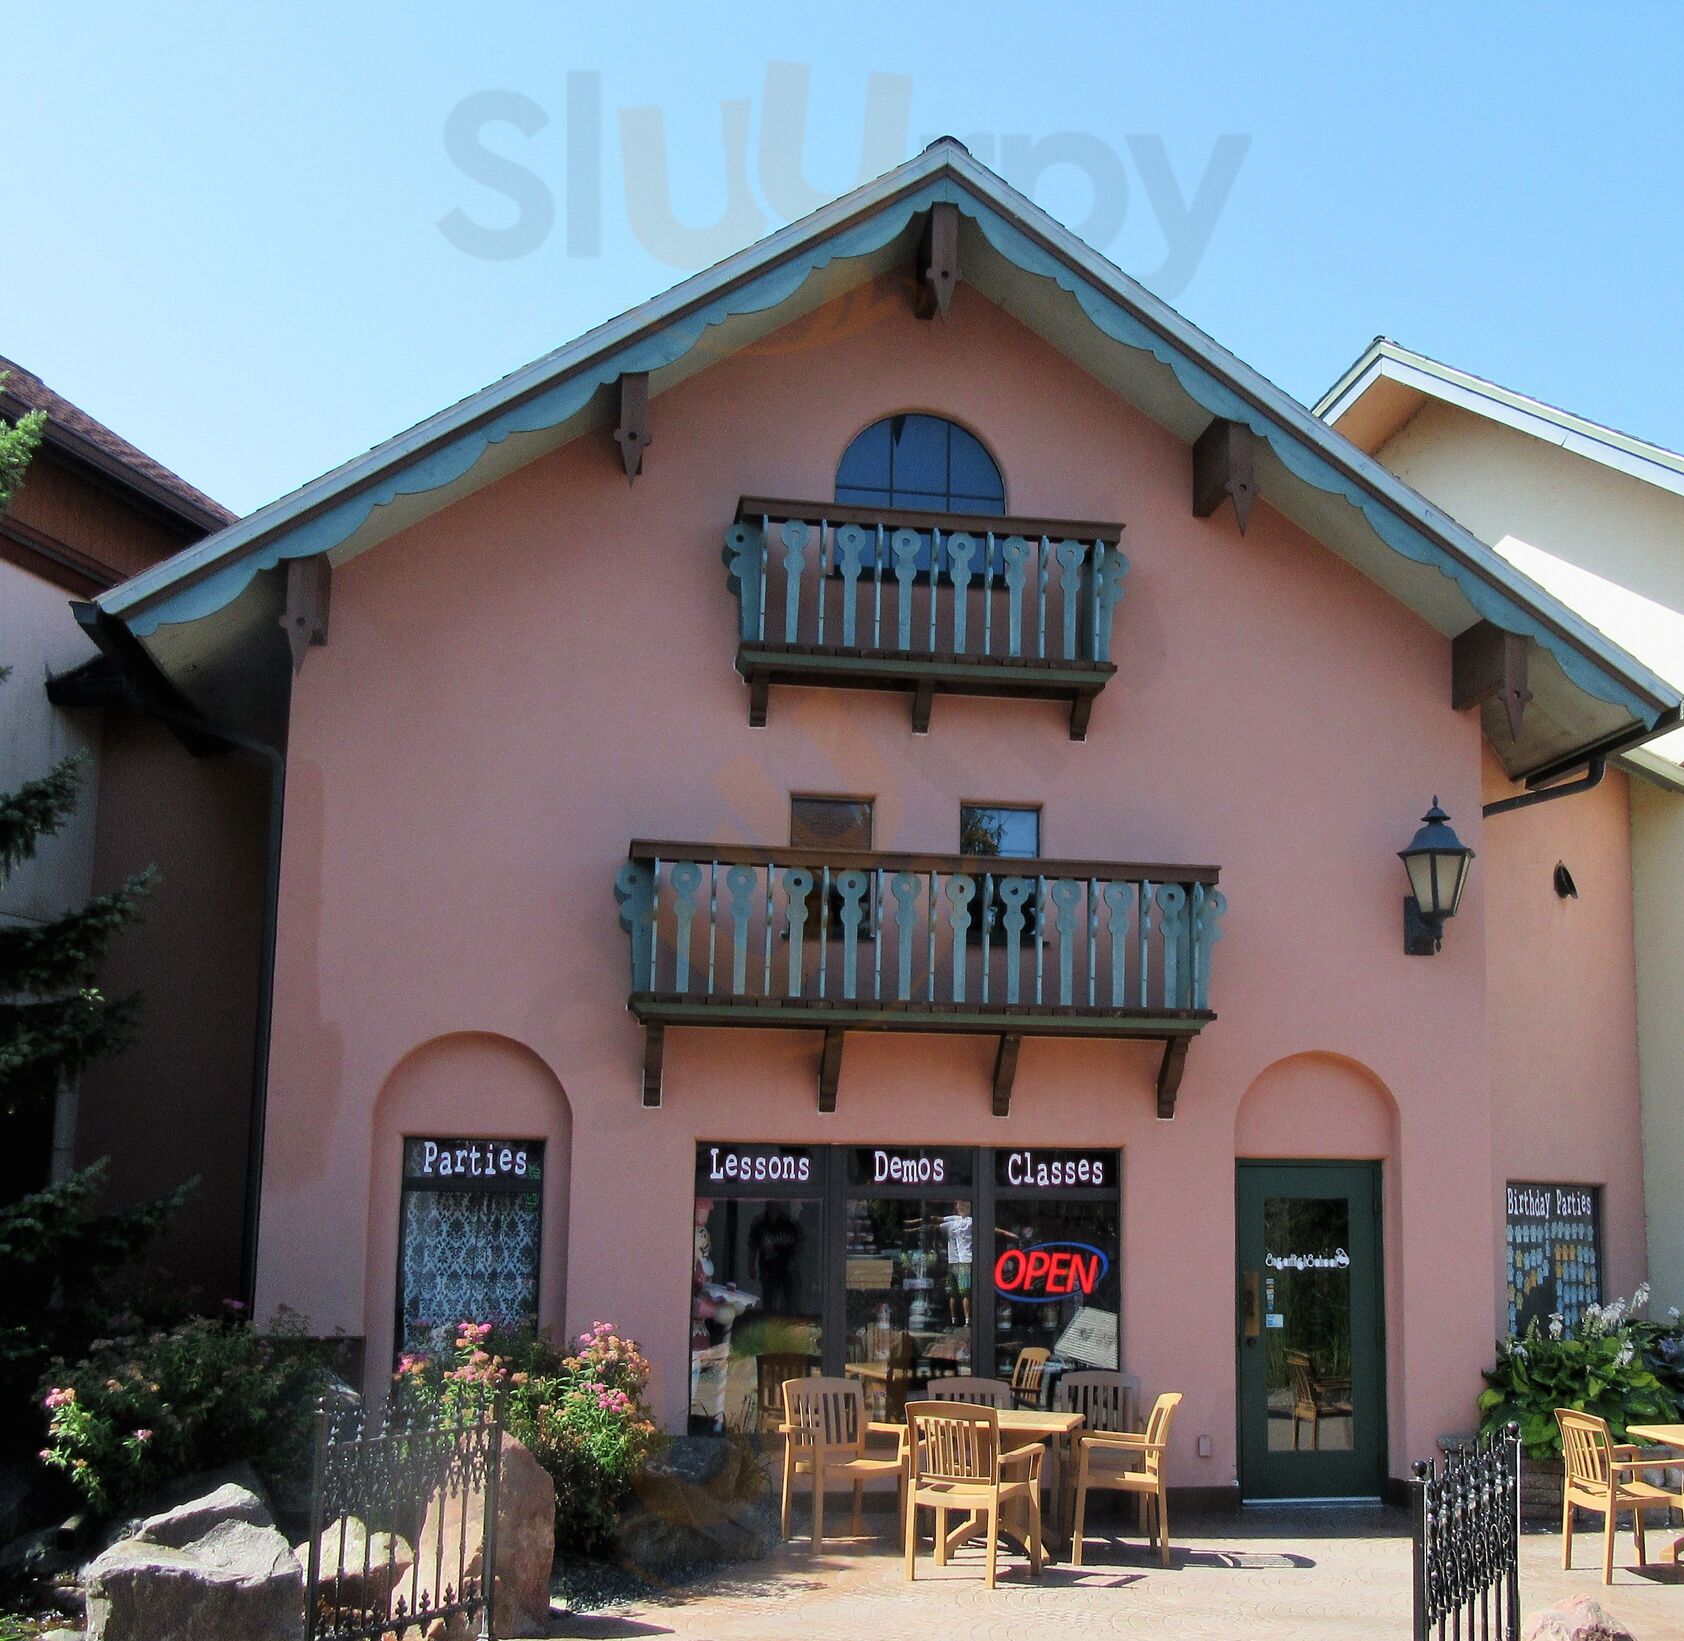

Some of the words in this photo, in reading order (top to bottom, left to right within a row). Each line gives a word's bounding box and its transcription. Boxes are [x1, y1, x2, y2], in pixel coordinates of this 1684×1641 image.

[423, 1141, 527, 1175] Parties
[710, 1148, 810, 1181] Lessons
[874, 1151, 945, 1182] Demos
[1008, 1152, 1104, 1186] Classes
[1507, 1188, 1551, 1219] Birthday
[1556, 1189, 1592, 1216] Parties
[994, 1248, 1099, 1295] OPEN
